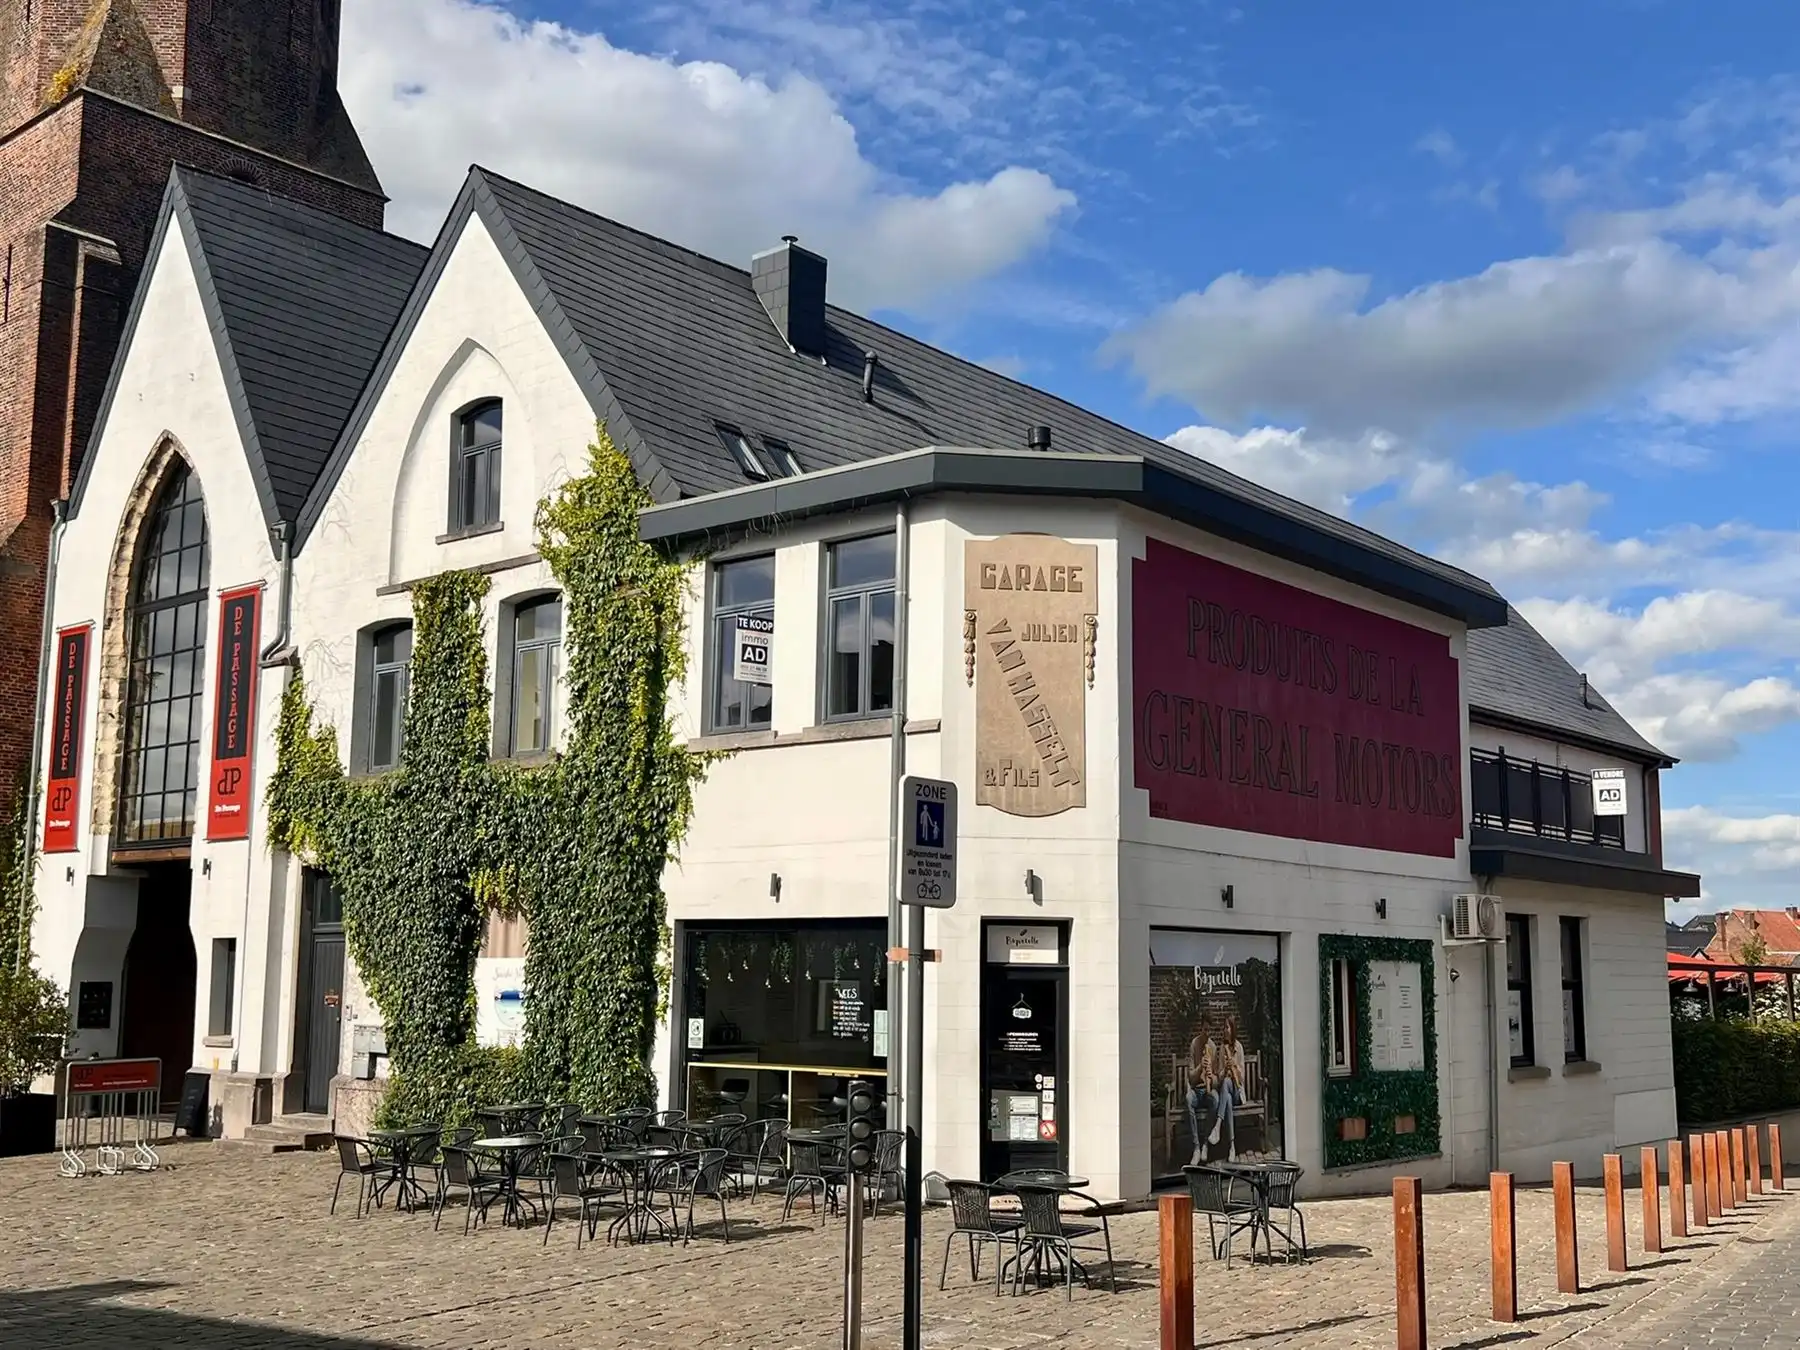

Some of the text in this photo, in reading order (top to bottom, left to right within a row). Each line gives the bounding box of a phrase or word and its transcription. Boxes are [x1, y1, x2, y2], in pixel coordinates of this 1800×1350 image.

[980, 562, 1083, 593] GARAGE
[738, 617, 773, 631] TE KOOP
[1021, 623, 1078, 644] JULIEN
[743, 646, 766, 662] AD
[1186, 597, 1425, 717] PRODUITS DE LA
[227, 605, 243, 750] DE PASSAGE
[60, 642, 77, 771] DE PASSAGE
[986, 617, 1081, 788] VAN HASSELT
[1143, 690, 1457, 819] GENERAL MOTORS
[984, 767, 997, 787] &
[915, 783, 948, 800] ZONE
[1600, 790, 1620, 801] AD
